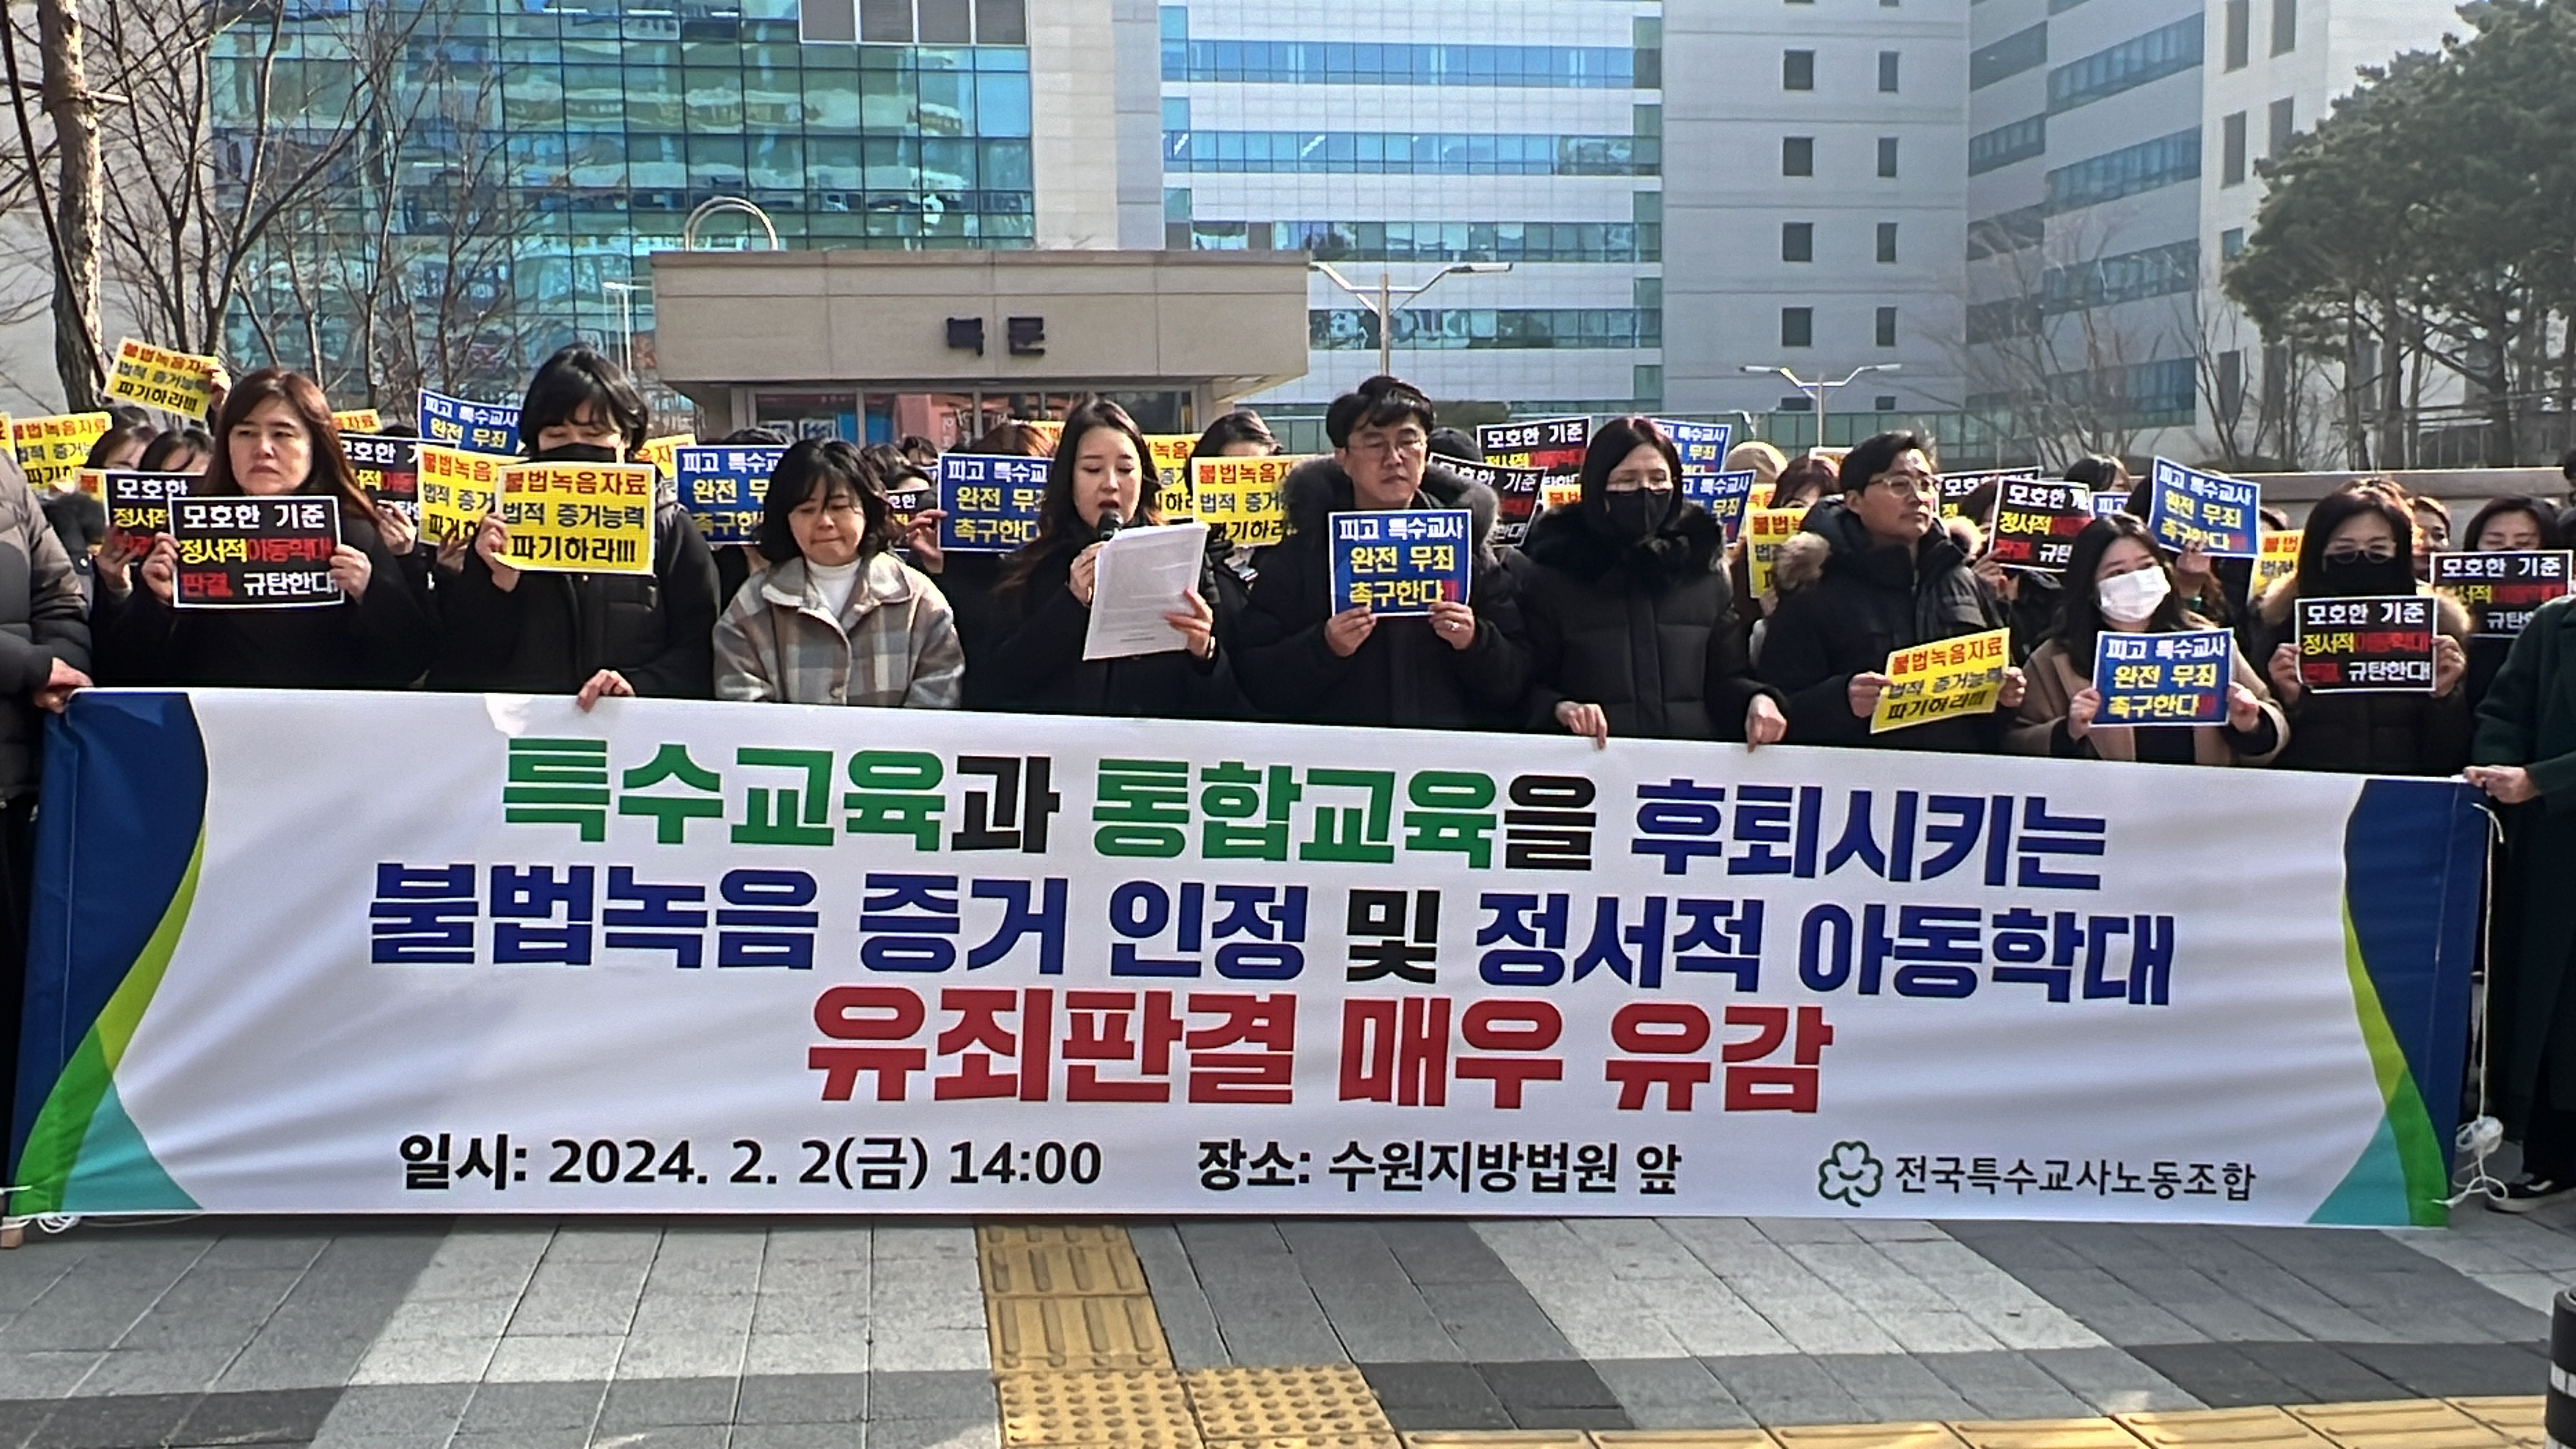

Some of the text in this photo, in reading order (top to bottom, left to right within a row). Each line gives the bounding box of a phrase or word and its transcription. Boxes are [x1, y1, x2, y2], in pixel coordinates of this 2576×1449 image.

[424, 396, 519, 427] 피고 특수교사
[430, 417, 508, 449] 완전 무죄
[1486, 422, 1584, 449] 모호한 기준
[682, 452, 720, 474] 피고
[947, 460, 985, 481] 피고
[505, 470, 647, 495] 불법녹음자료
[692, 479, 738, 504] 완전
[1503, 473, 1537, 493] 기준
[2158, 464, 2253, 506] 피고 특수교사
[956, 486, 1001, 512] 완전
[1200, 492, 1235, 513] 법적
[2007, 484, 2066, 509] 모호한
[183, 503, 326, 529] 모호한 기준
[503, 502, 645, 529] 법적 증거능력
[2201, 503, 2242, 529] 무죄
[1338, 517, 1464, 542] 피고 특수교사
[1350, 544, 1455, 574] 완전 무죄
[2442, 557, 2561, 578] 모호한 기준
[2307, 602, 2425, 625] 모호한 기준
[1892, 637, 2003, 675] 불법녹음자료
[2106, 635, 2226, 660] 피고 특수교사
[2113, 663, 2217, 689] 완전 무죄
[503, 738, 2106, 891] 특수교육과 통합교육을 후퇴시키는
[370, 862, 2174, 1006] 불법녹음 증거 인정 및 정서적 아동학대
[808, 985, 1834, 1114] 유죄판결 매우 유감
[399, 1133, 1101, 1191] 일시: 2024. 2. 2(금) 14:00
[1197, 1137, 1682, 1196] 장소: 수원지방법원 앞
[1894, 1154, 2257, 1202] 전국특수교사노동조합
